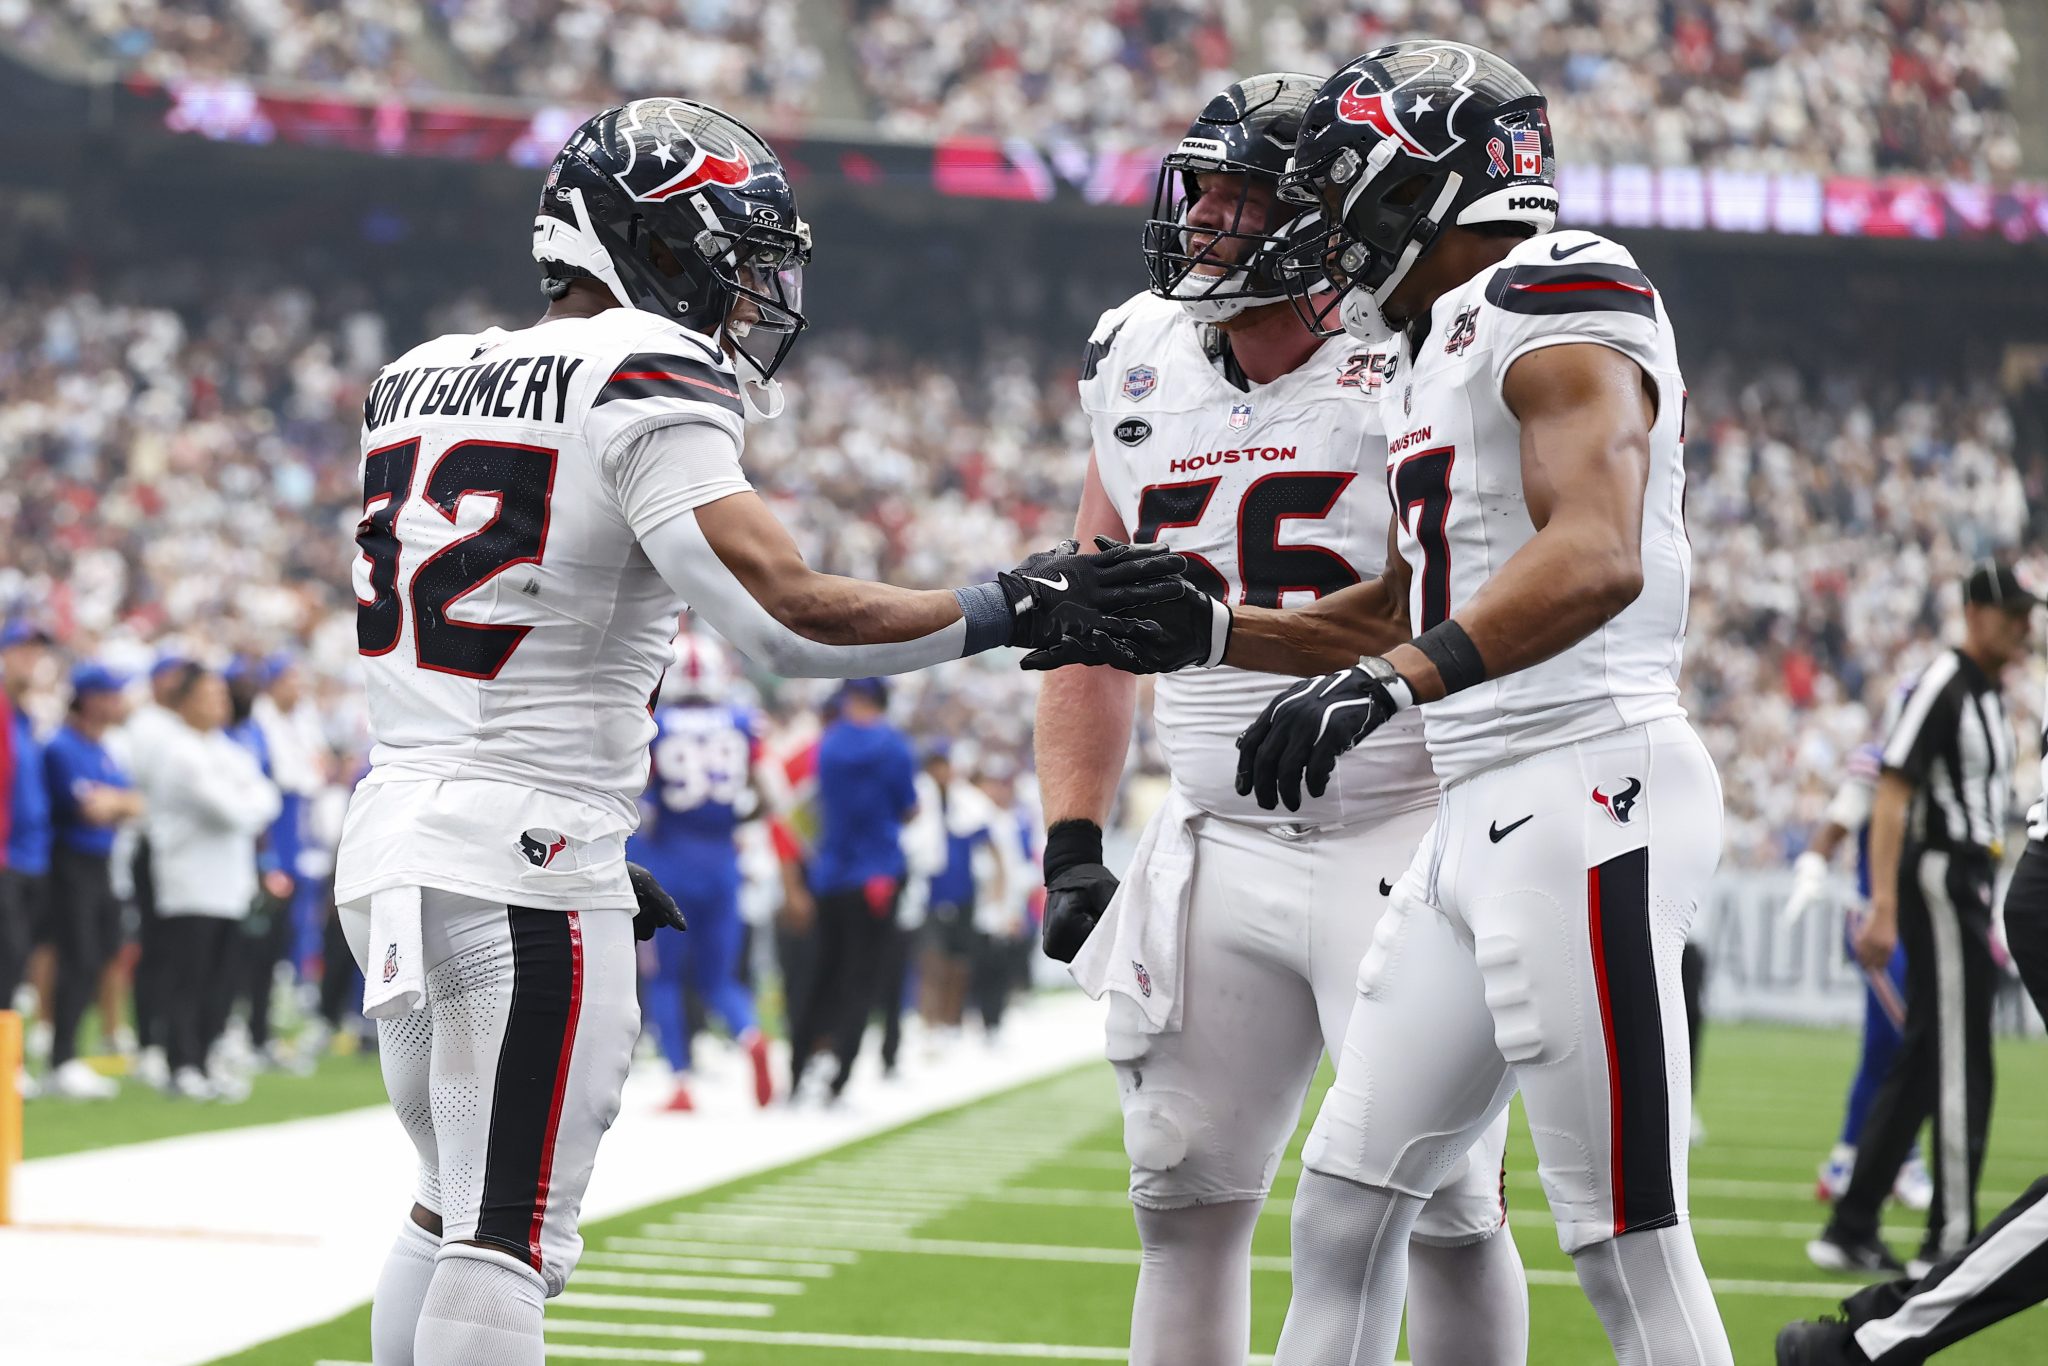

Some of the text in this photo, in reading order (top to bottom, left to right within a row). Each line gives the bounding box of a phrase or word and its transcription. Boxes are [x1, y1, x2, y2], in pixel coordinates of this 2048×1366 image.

[1182, 141, 1218, 151] TEXANS
[753, 217, 782, 229] OAKLEY
[1389, 426, 1432, 455] HOUSTON
[1170, 446, 1297, 473] HOUSTON
[1386, 445, 1456, 637] 7
